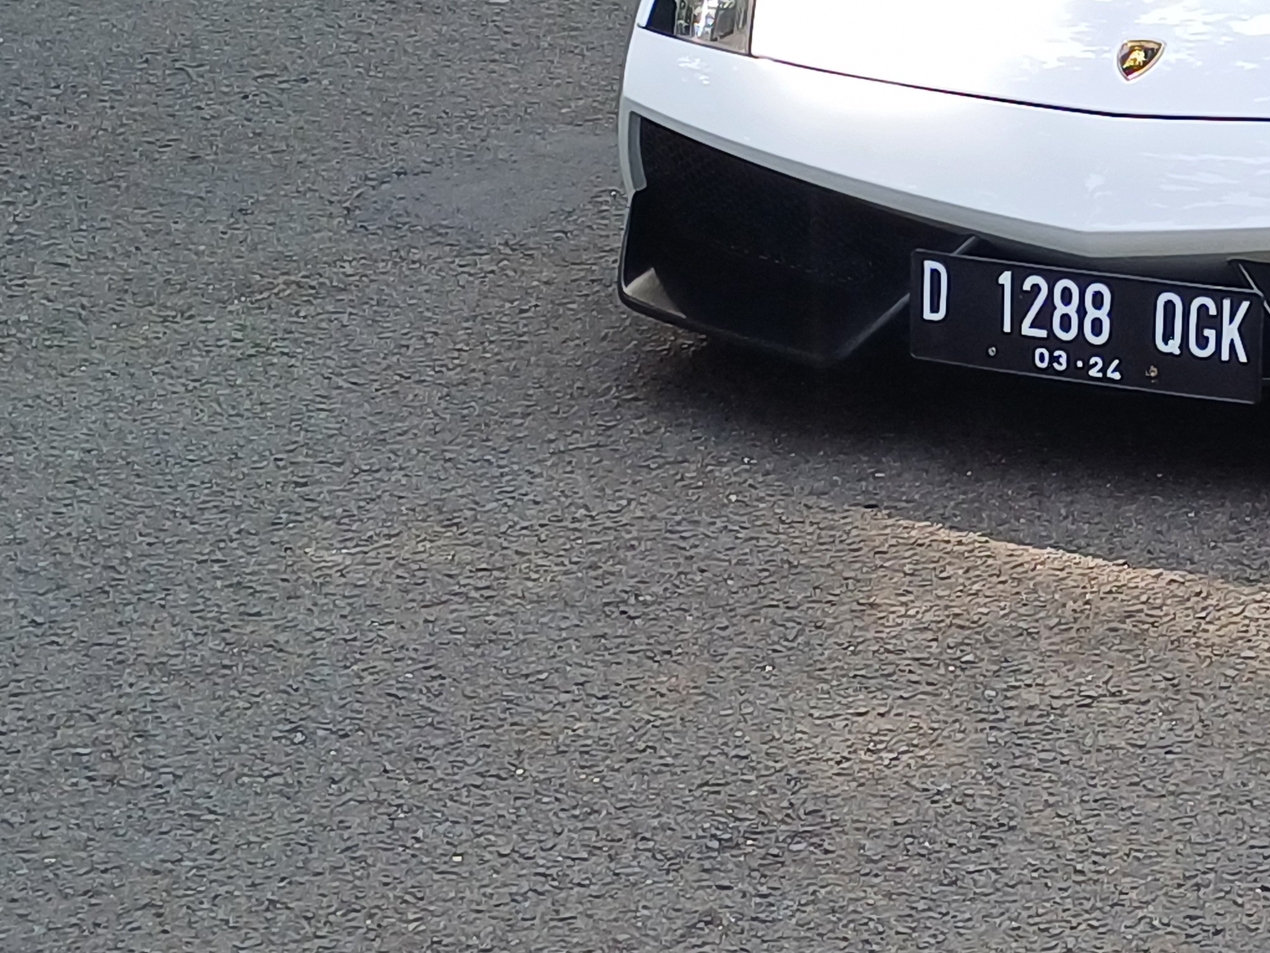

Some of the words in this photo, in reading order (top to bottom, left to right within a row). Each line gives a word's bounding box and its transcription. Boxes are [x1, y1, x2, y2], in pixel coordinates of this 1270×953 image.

[922, 259, 948, 322] D
[998, 270, 1112, 346] 1288
[1155, 292, 1251, 364] QGK
